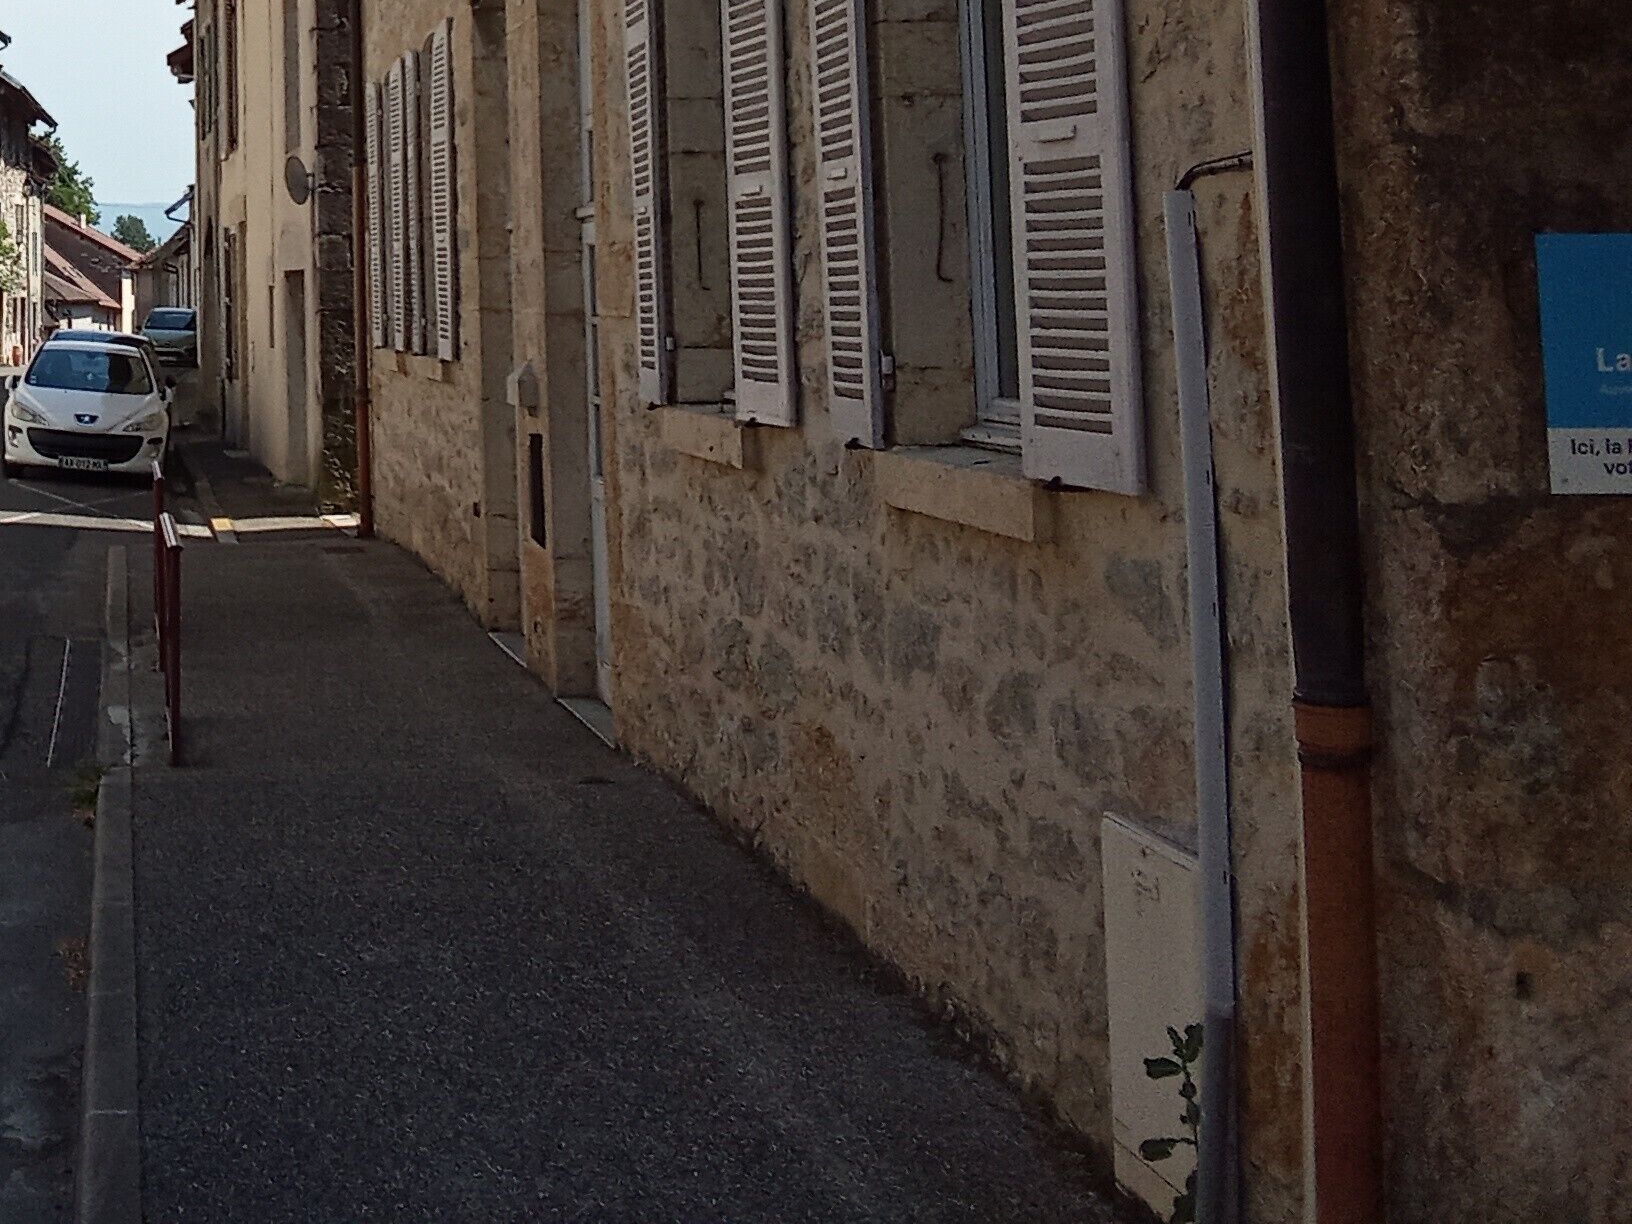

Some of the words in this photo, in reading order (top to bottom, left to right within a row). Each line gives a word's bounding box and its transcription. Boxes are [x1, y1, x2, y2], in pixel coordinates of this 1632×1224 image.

[1596, 347, 1632, 373] La
[1571, 438, 1600, 456] Ici,
[1605, 438, 1622, 454] la
